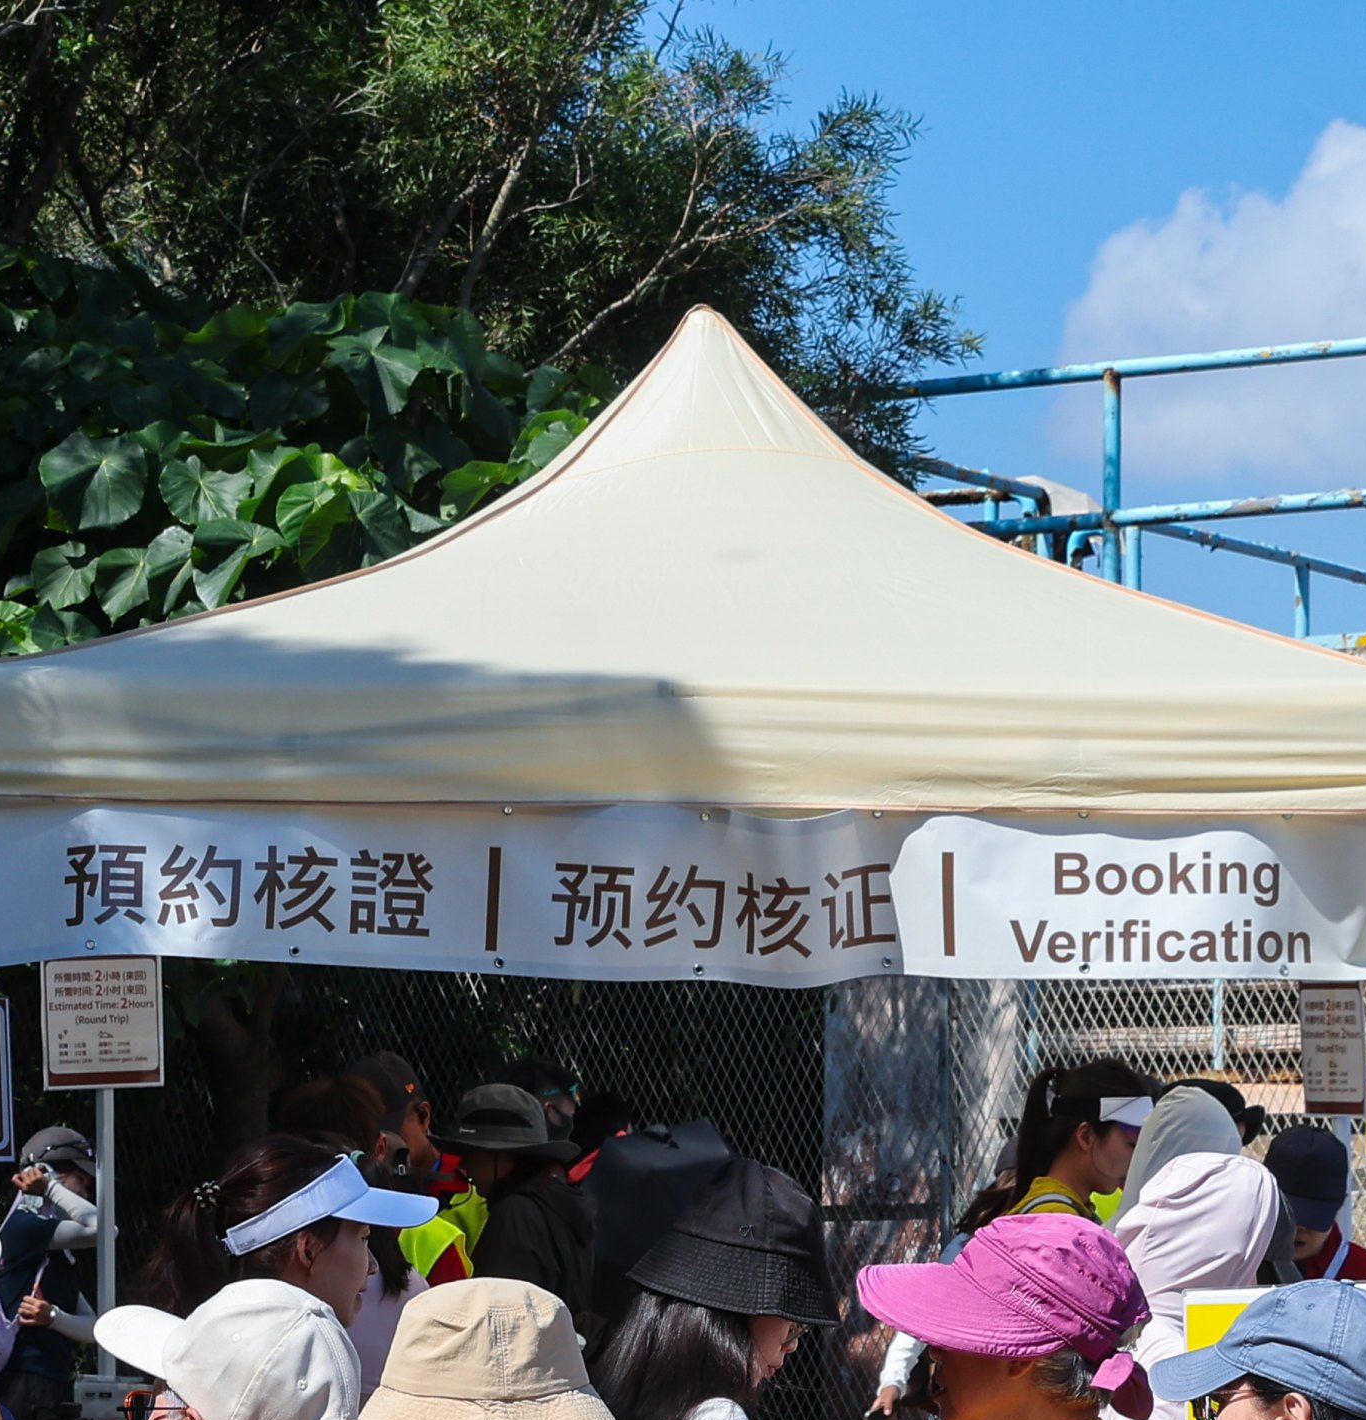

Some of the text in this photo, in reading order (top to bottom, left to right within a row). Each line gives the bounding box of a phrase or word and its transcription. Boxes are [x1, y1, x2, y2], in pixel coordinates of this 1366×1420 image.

[64, 844, 897, 959] 預約核證 预约核证
[1053, 851, 1282, 907] Booking
[1010, 919, 1313, 966] Verification
[48, 1001, 93, 1012] Estimated
[75, 1014, 129, 1026] (Round Trip)
